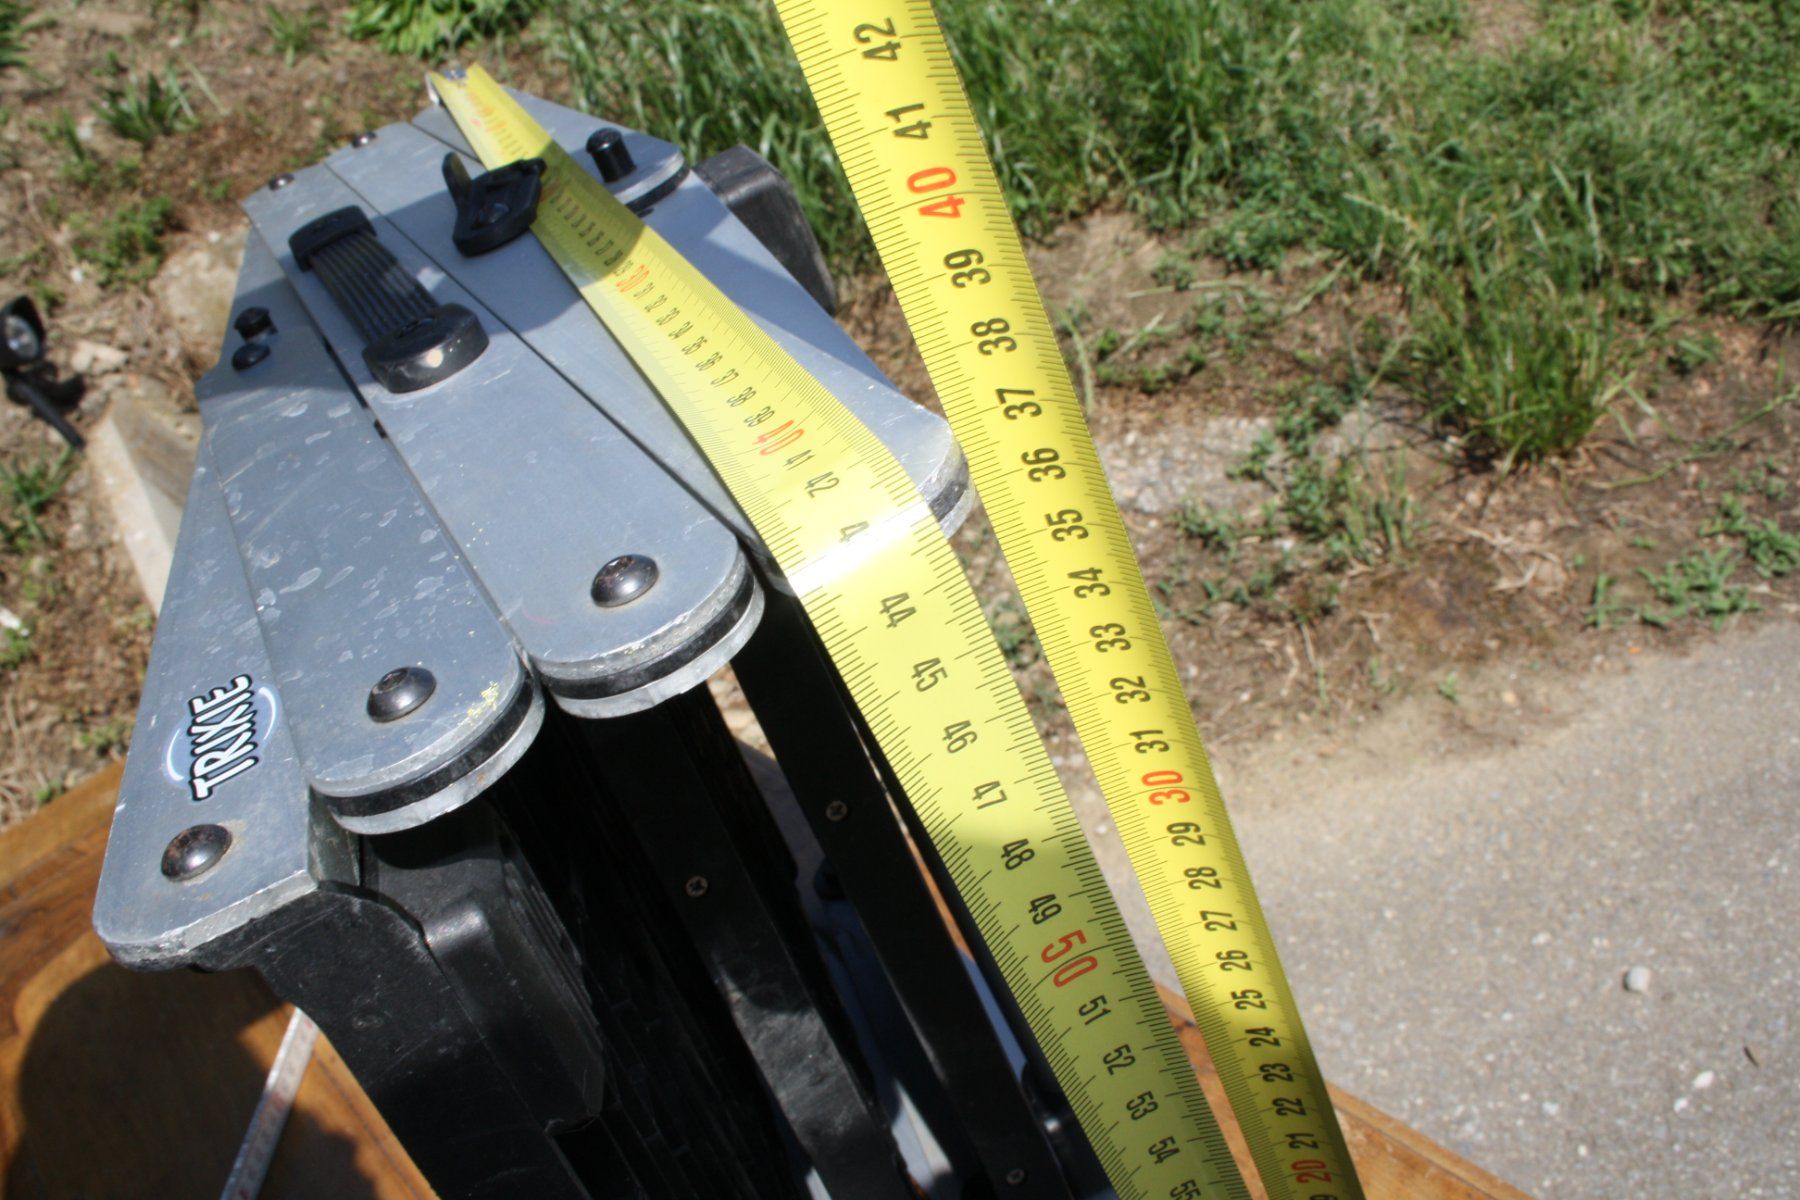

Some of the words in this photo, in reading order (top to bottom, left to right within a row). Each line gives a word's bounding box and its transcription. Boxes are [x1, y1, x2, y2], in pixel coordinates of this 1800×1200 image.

[853, 17, 901, 61] 42
[885, 103, 932, 139] 41
[907, 166, 965, 218] 40
[943, 248, 991, 288] 39
[681, 335, 707, 355] 35
[971, 317, 1017, 356] 38
[695, 352, 723, 371] 36
[710, 368, 739, 388] 37
[726, 386, 756, 407] 38
[995, 388, 1042, 420] 37
[743, 405, 775, 427] 39
[752, 419, 804, 456] 40
[784, 449, 816, 471] 41
[1021, 448, 1066, 482] 36
[805, 471, 840, 498] 42
[1044, 509, 1089, 542] 35
[1067, 567, 1111, 599] 34
[879, 592, 917, 629] 44
[1089, 622, 1131, 653] 33
[911, 657, 948, 692] 45
[1109, 676, 1151, 704] 32
[188, 674, 258, 801] TRIXIE
[942, 720, 978, 754] 46
[1129, 729, 1170, 754] 31
[972, 780, 1008, 810] 47
[1141, 770, 1190, 806] 30
[1166, 821, 1206, 846] 29
[1001, 838, 1035, 871] 48
[1184, 866, 1222, 890] 28
[1028, 894, 1062, 925] 49
[1200, 910, 1238, 931] 27
[1041, 929, 1099, 988] 50
[1216, 950, 1252, 971] 26
[1078, 995, 1111, 1025] 51
[1231, 989, 1267, 1010] 25
[1245, 1027, 1281, 1047] 24
[1102, 1044, 1136, 1075] 52
[1259, 1063, 1294, 1082] 23
[1125, 1091, 1158, 1121] 53
[1272, 1097, 1306, 1116] 22
[1147, 1136, 1181, 1165] 54
[1285, 1133, 1318, 1149] 21
[1291, 1160, 1331, 1183] 20
